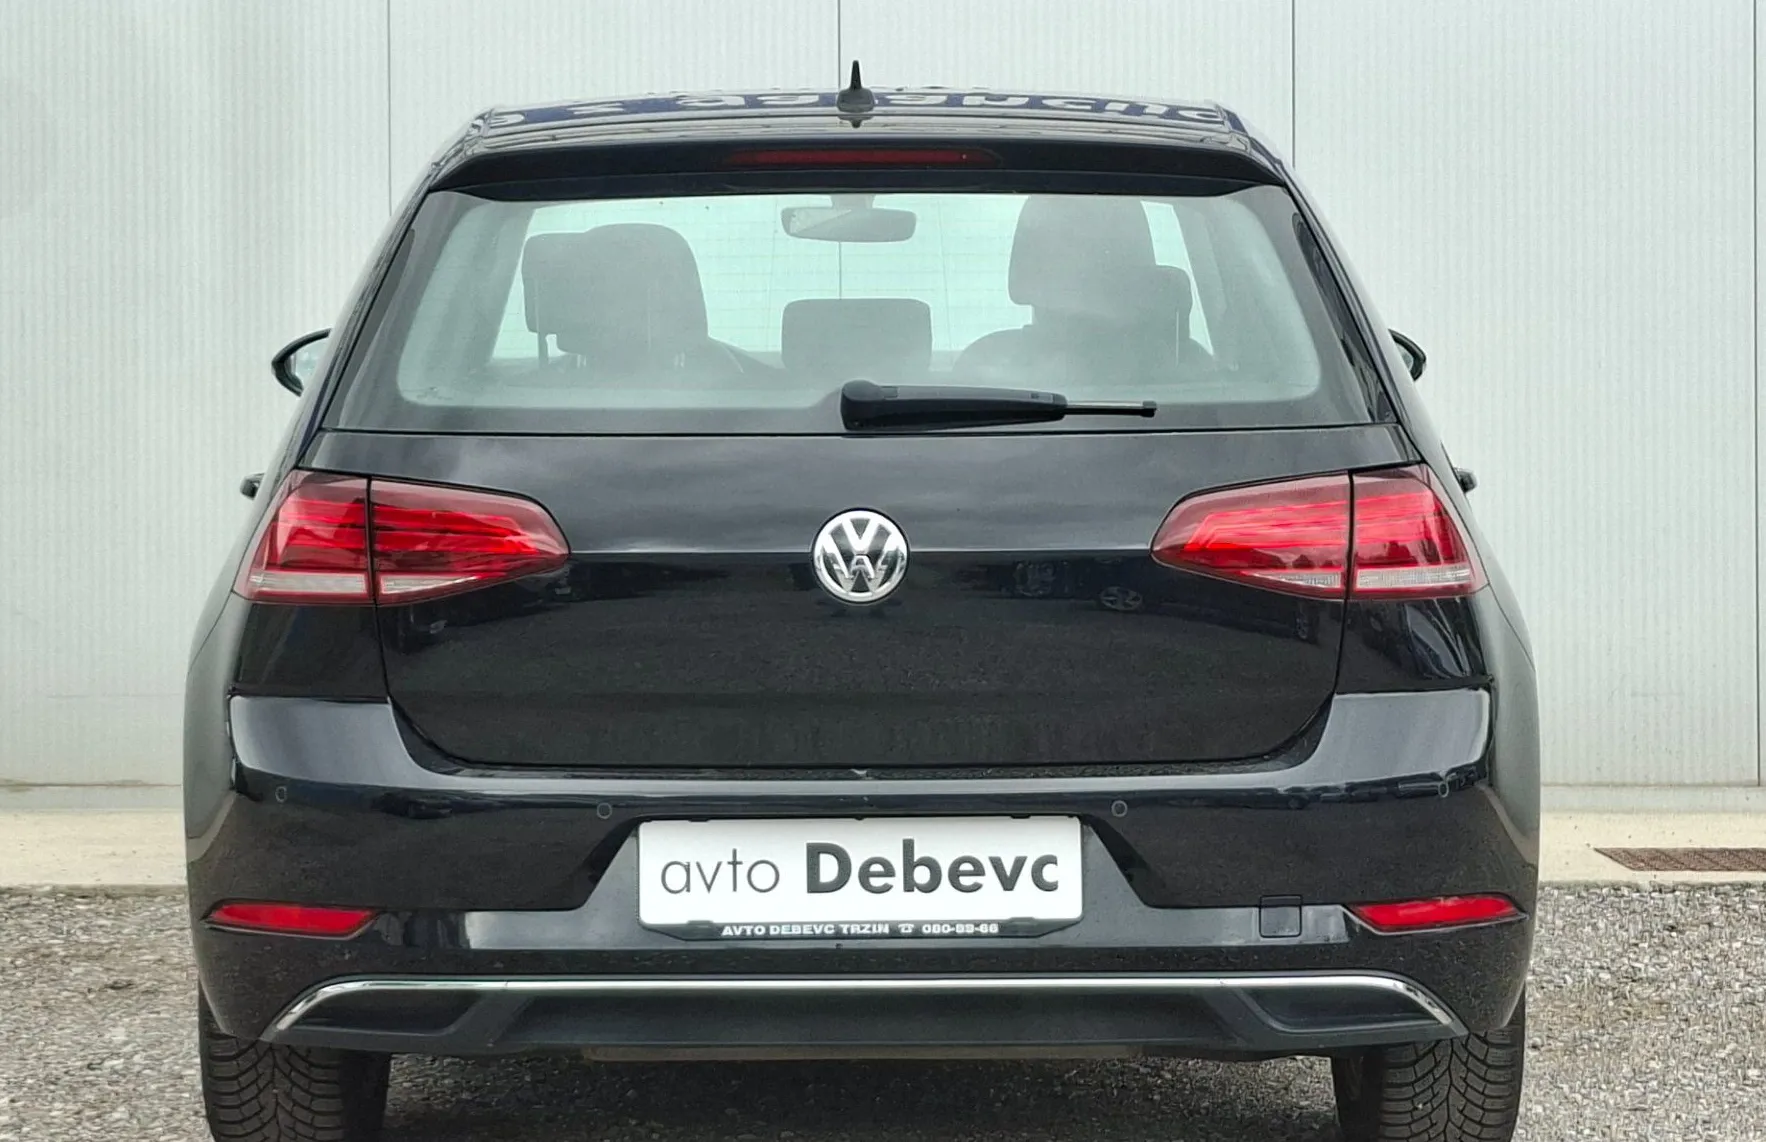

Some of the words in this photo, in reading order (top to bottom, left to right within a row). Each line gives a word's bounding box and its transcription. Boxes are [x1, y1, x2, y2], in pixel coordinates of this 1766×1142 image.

[660, 848, 781, 894] avto
[805, 838, 1059, 894] Debevc
[721, 924, 766, 936] AVTO
[769, 923, 836, 935] DEBEVC
[839, 923, 890, 935] TRZIN
